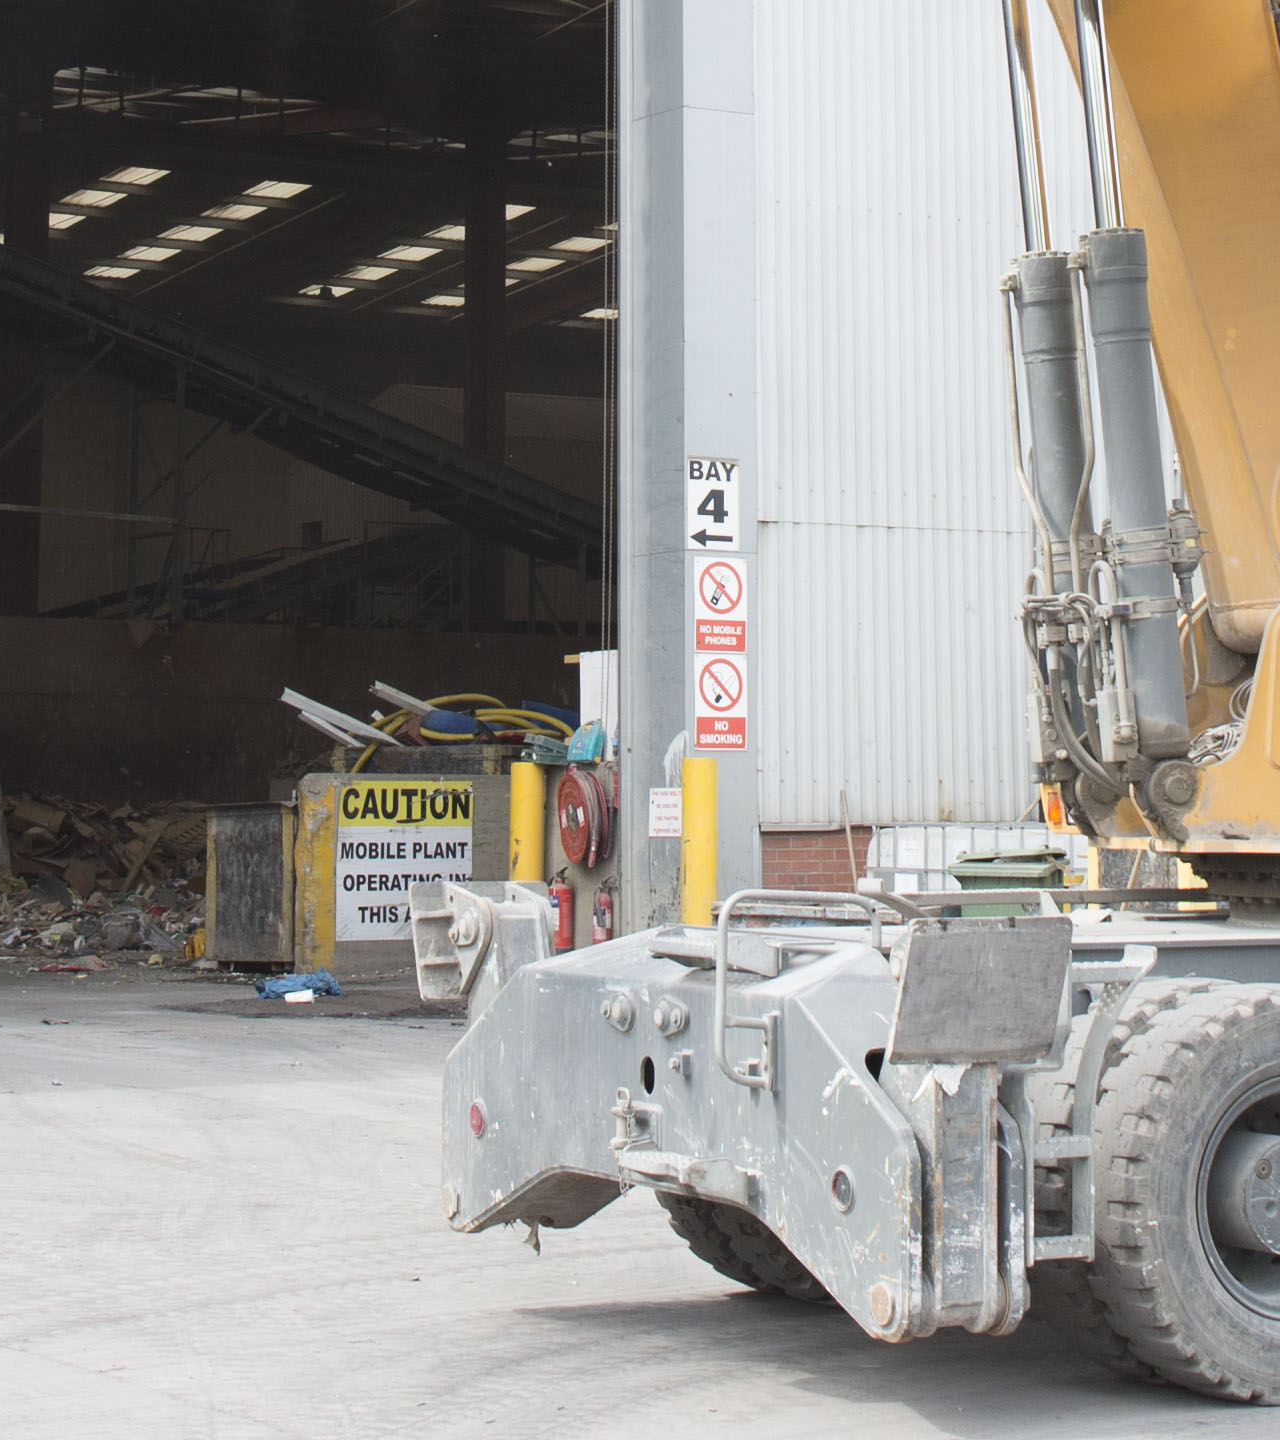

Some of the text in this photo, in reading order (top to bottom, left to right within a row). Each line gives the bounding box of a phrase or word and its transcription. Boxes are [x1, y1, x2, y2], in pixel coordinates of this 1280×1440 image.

[689, 460, 736, 482] BAY
[696, 489, 728, 523] 4
[699, 625, 742, 635] NO MOBILE
[705, 636, 737, 646] PHONES
[714, 720, 729, 731] NO
[699, 733, 743, 744] SMOKING
[342, 787, 470, 820] CAUTION
[340, 842, 468, 860] MOBILE PLANT
[358, 905, 399, 923] THIS
